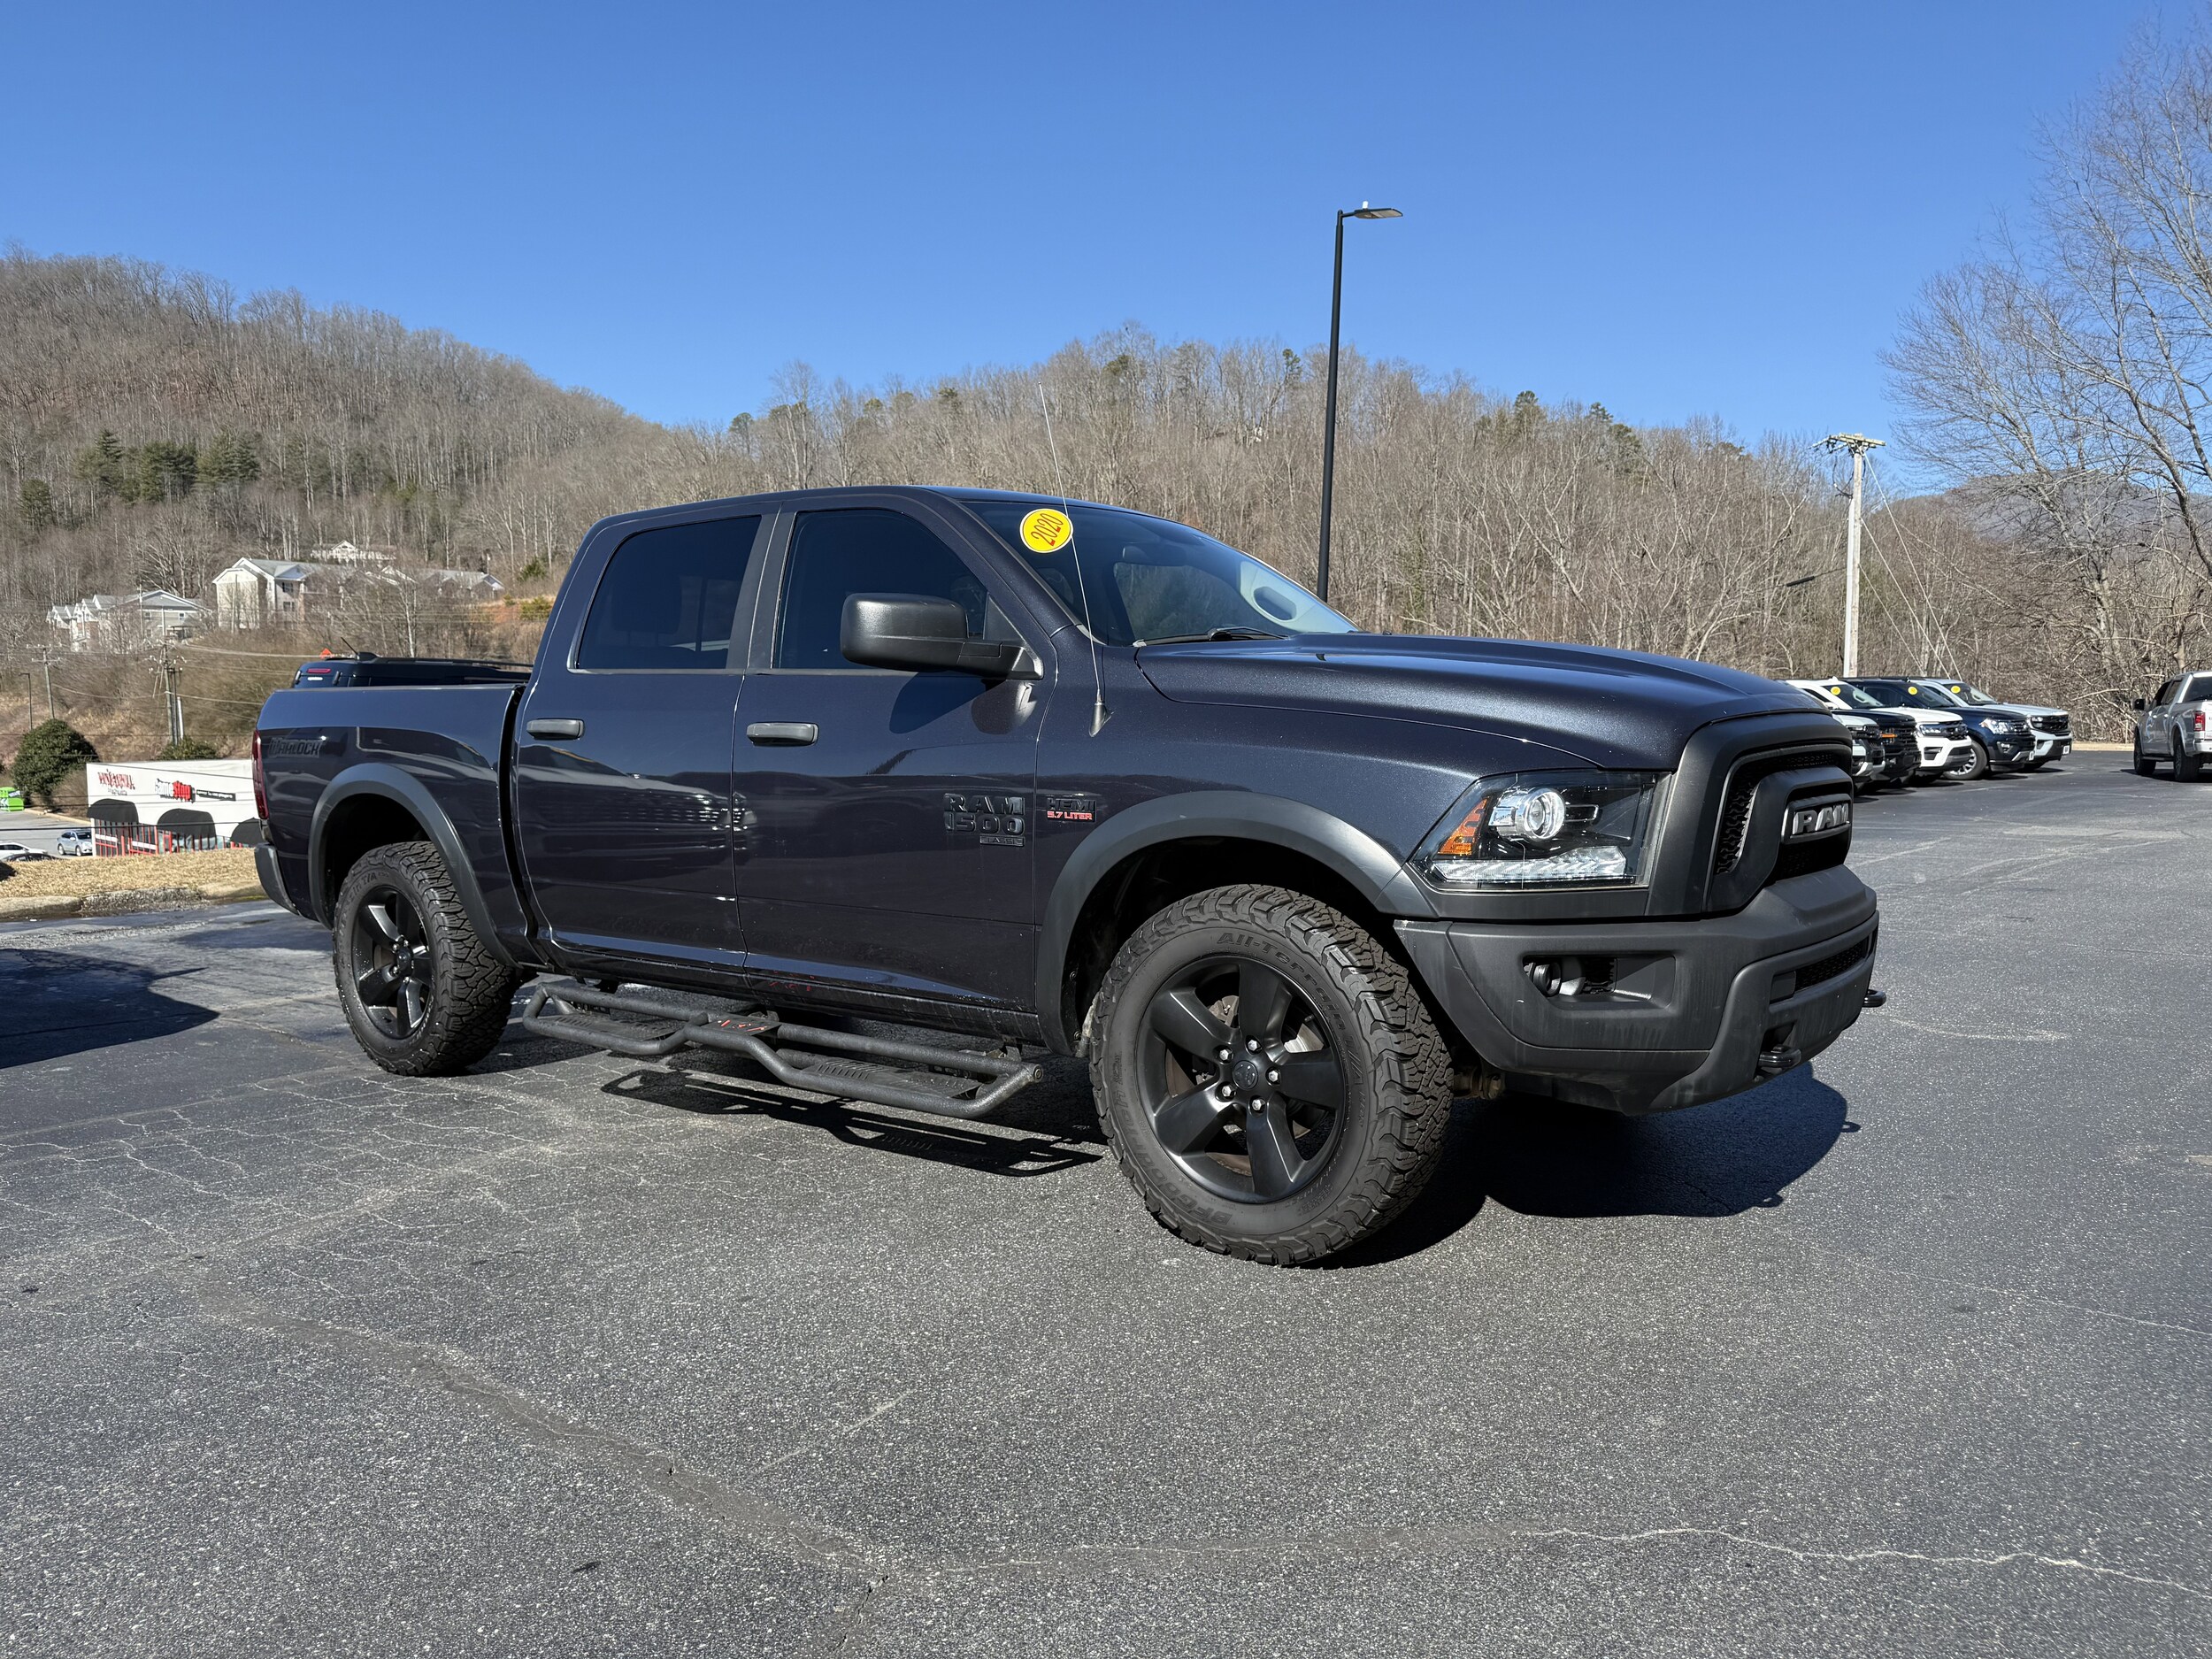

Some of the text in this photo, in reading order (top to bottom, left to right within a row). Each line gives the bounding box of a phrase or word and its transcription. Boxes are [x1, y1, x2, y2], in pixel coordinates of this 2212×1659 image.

[1031, 513, 1064, 547] 2020
[943, 793, 1025, 815] RAM
[1047, 797, 1096, 811] HEMI
[943, 812, 1025, 835] 1500
[1064, 811, 1093, 820] LITER
[1792, 803, 1850, 835] RAM
